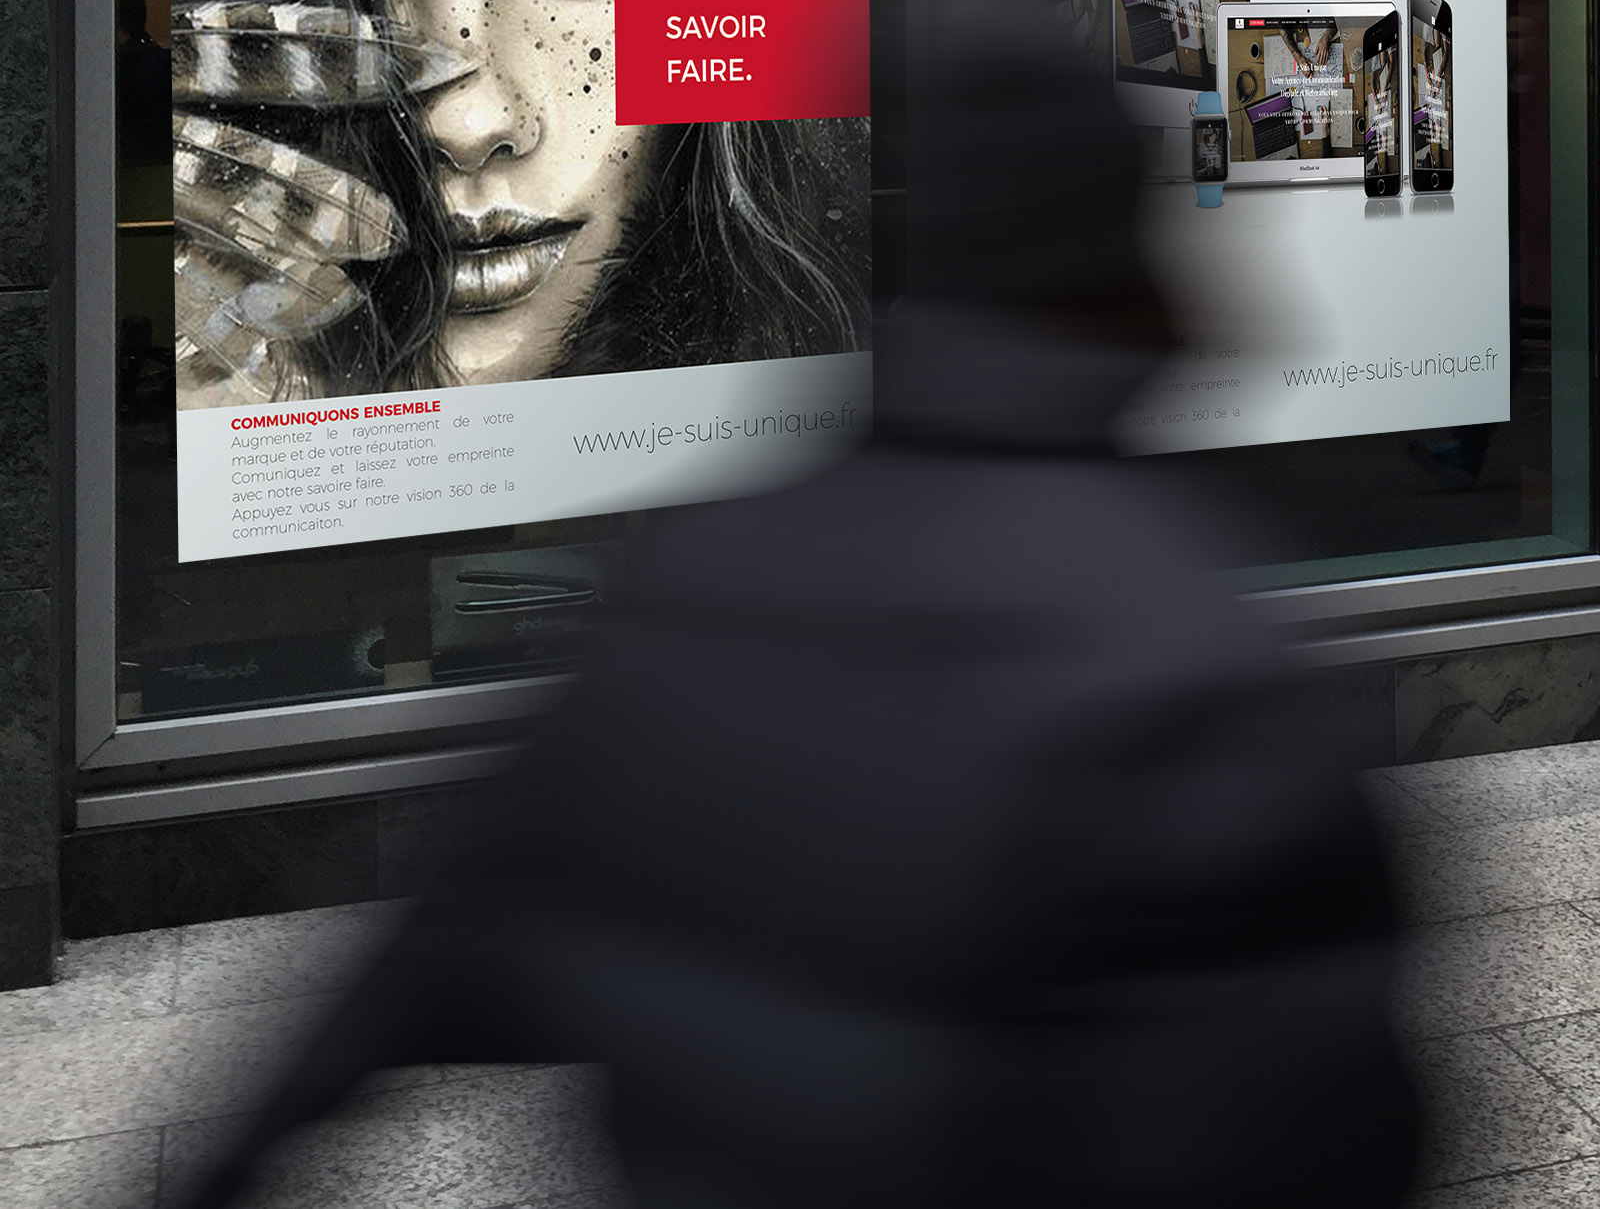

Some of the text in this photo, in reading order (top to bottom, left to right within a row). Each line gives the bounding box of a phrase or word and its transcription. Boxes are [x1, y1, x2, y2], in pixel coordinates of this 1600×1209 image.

[666, 15, 767, 40] SAVOIR
[667, 58, 752, 83] FAIRE.
[1283, 347, 1498, 389] www.je-suis-unique.fr
[1191, 378, 1240, 392] empreinte
[230, 400, 441, 430] COMMUNIQUONS ENSEMBLE
[231, 412, 515, 449] Augmentez le rayonnement de votre
[573, 401, 857, 454] www.je-suis-unique.fr
[231, 437, 436, 468] marque et de votre réputation.
[231, 446, 515, 486] Comuniquez et laissez votre empreinte
[231, 475, 386, 504] avec notre savoire faire.
[231, 478, 515, 523] Appuyez vous sur notre vision 360 de la
